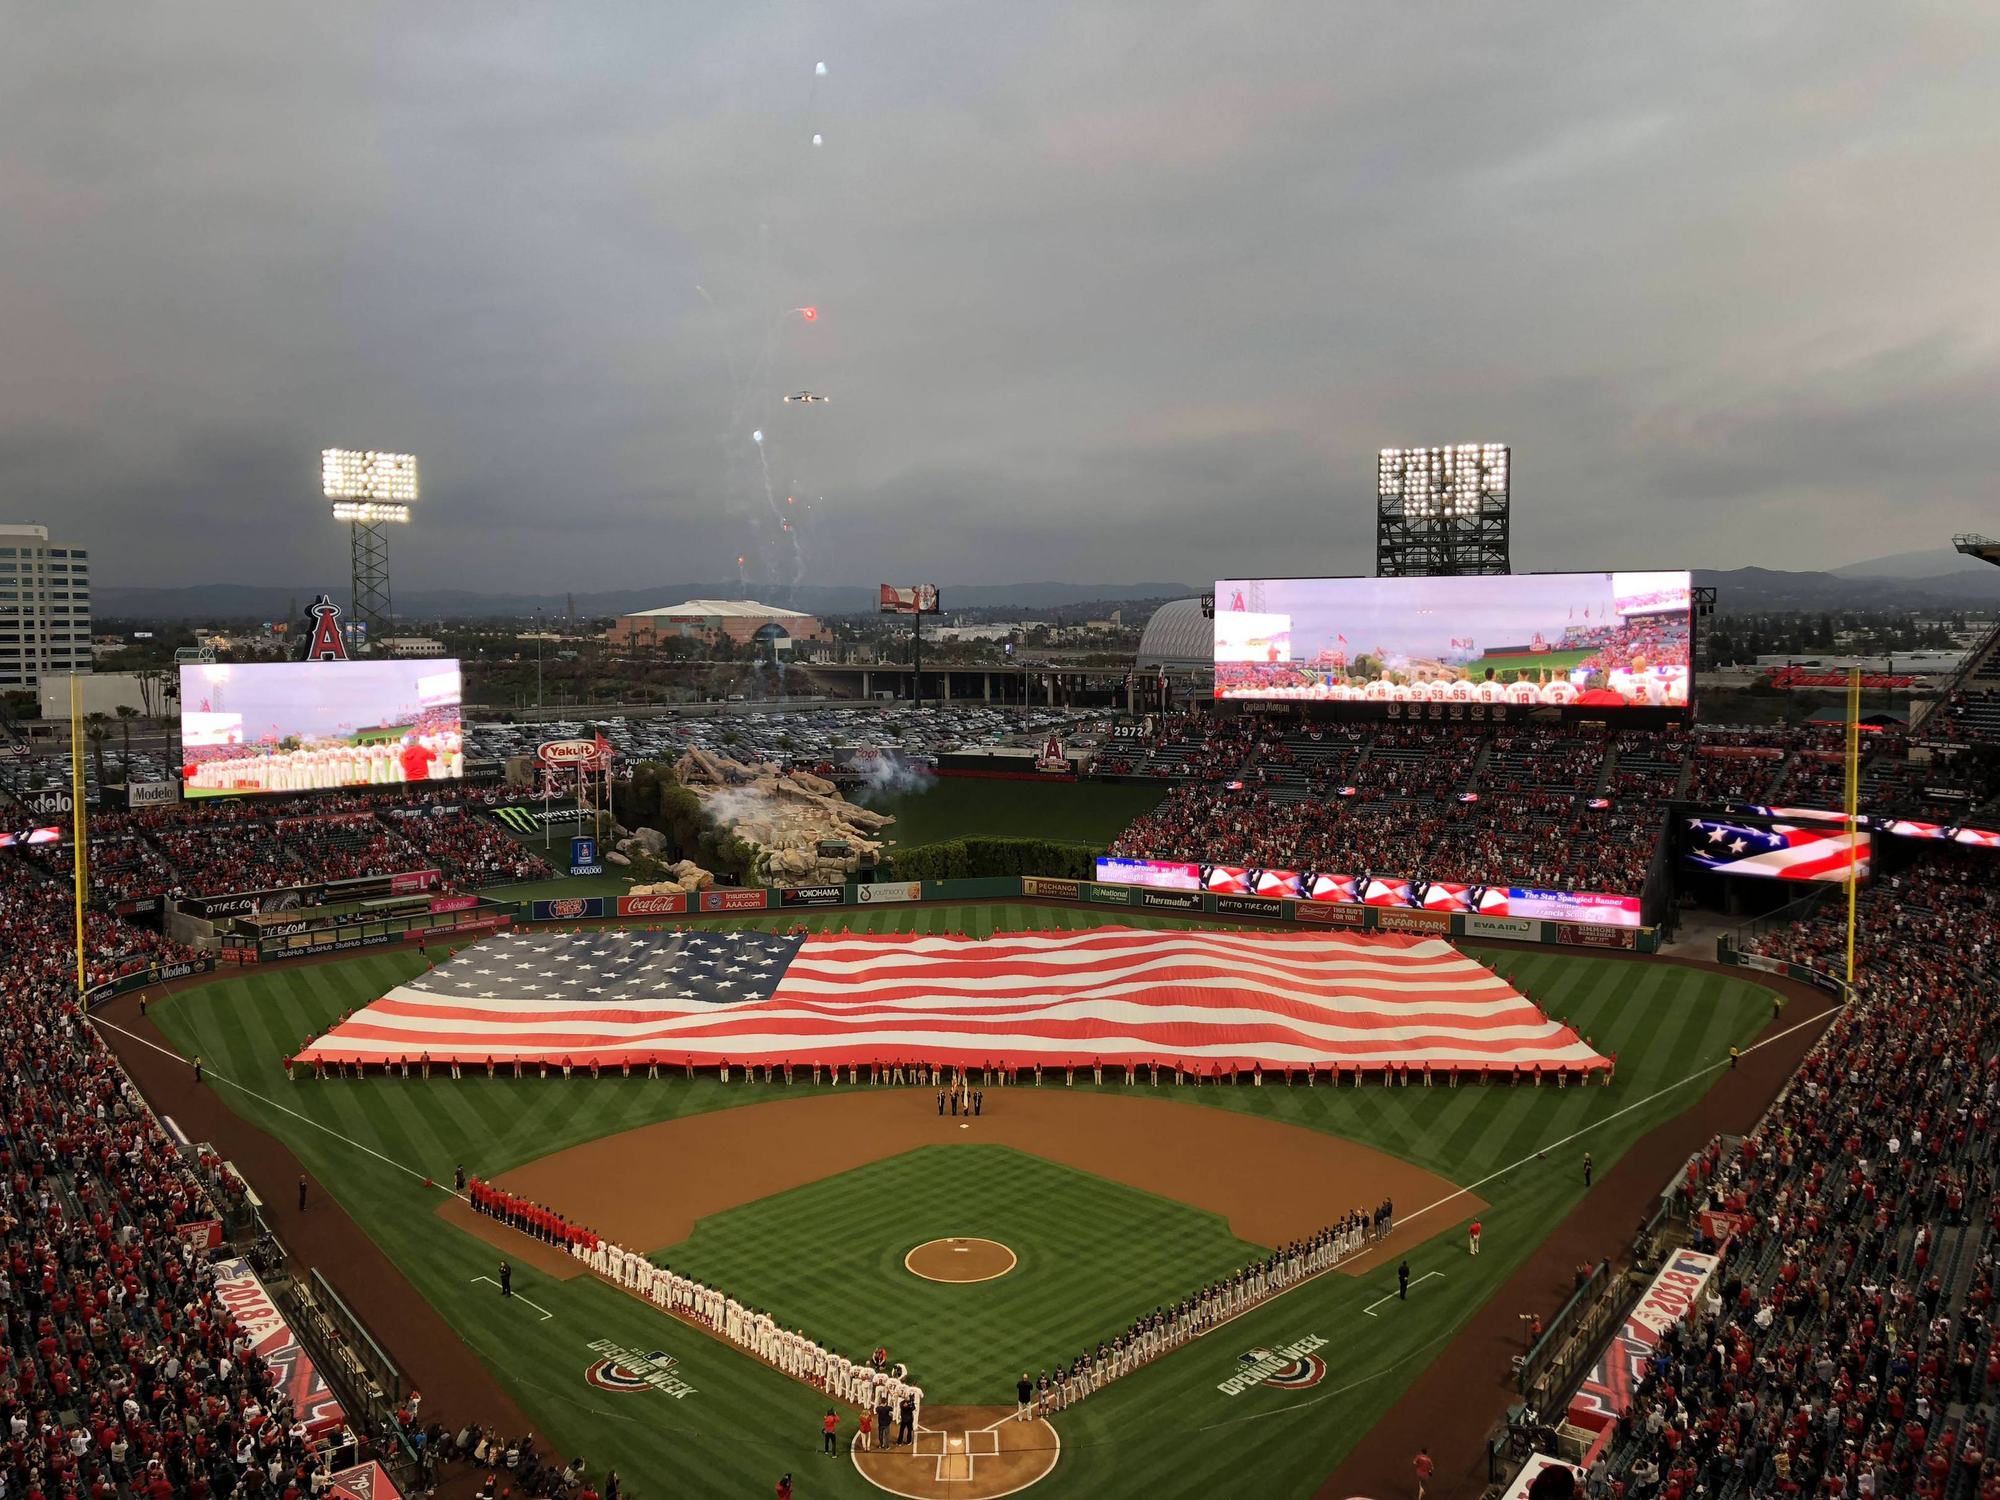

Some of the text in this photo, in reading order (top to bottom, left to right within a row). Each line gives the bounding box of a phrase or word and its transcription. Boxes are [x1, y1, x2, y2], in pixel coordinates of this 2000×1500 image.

[1243, 702, 1290, 713] Captain Morgan
[1114, 727, 1143, 737] 2972
[550, 745, 592, 757] Yakult
[626, 766, 634, 778] 6
[136, 787, 173, 801] Modelo
[797, 888, 840, 898] YOKOHAMA
[1038, 883, 1077, 892] PECHANGA
[1100, 889, 1128, 897] National
[725, 892, 760, 900] Insurance
[1144, 894, 1192, 907] Thermador
[1524, 890, 1623, 905] The Star Spangled Banner
[725, 901, 761, 909] AAA.com
[1219, 900, 1279, 912] NITTO TIRE.COM
[1382, 917, 1447, 930] SAFARI PARK
[277, 936, 388, 958] StubHub StubHub StubHub StubHub
[161, 964, 191, 979] Modelo
[1644, 1271, 1700, 1317] 2018
[214, 1280, 274, 1322] 2018
[586, 1338, 699, 1400] OPENING WEEK
[1216, 1333, 1330, 1396] OPENING WEEK
